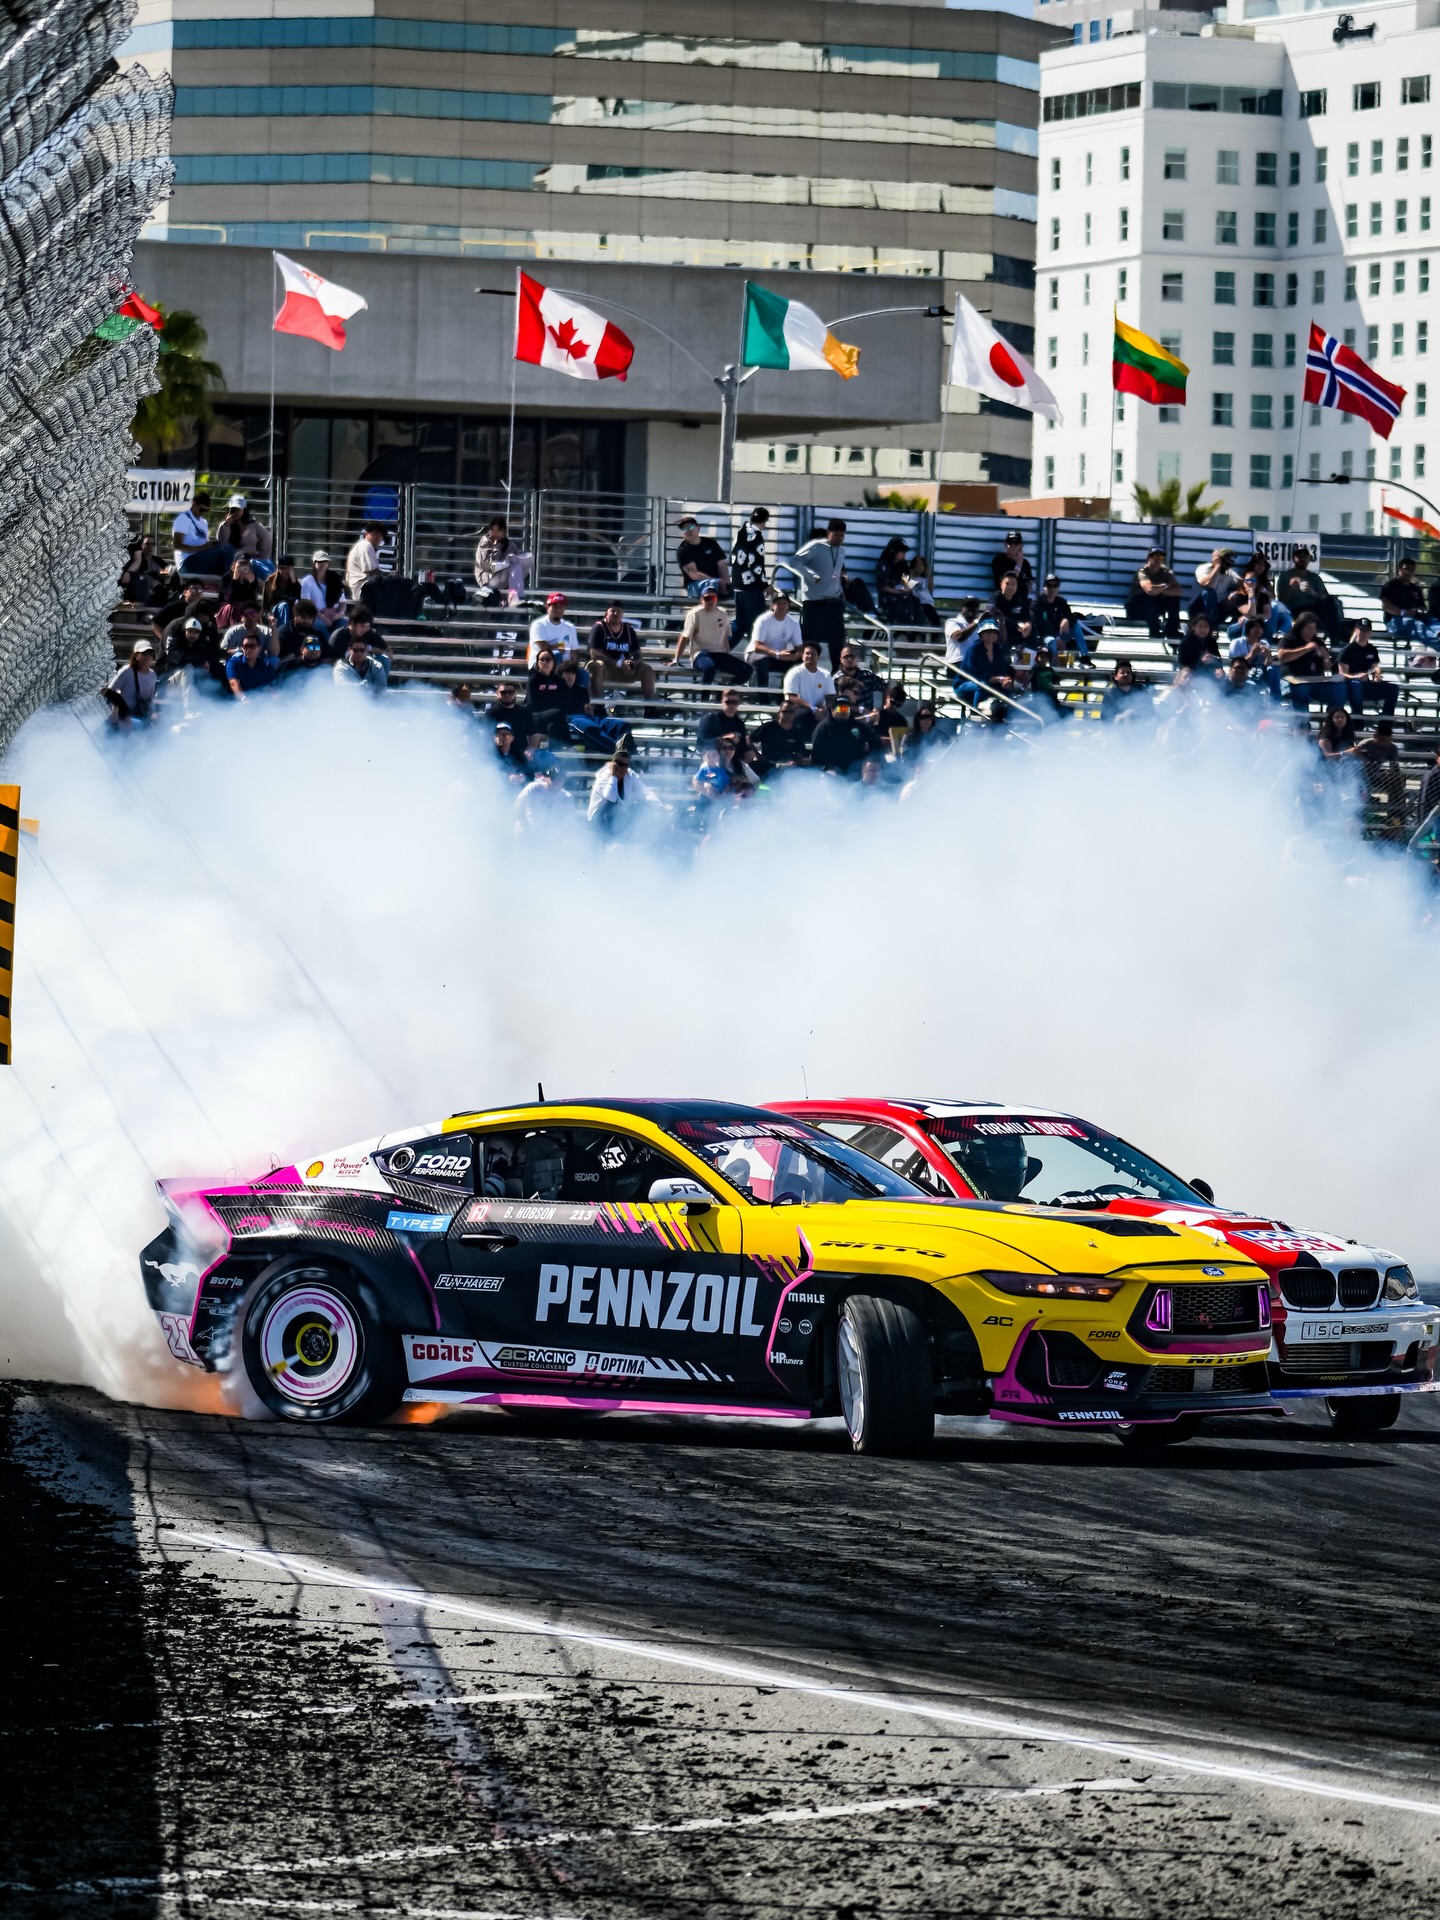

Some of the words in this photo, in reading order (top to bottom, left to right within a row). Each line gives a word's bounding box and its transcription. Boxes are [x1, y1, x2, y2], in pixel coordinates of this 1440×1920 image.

[130, 480, 180, 501] ECTION
[183, 482, 191, 502] 2
[1310, 544, 1318, 562] 3
[973, 1122, 1041, 1135] FORMULA
[1032, 1121, 1082, 1136] DRIFT
[415, 1155, 471, 1170] FORD
[411, 1166, 466, 1178] PERFORMANCE
[575, 1173, 600, 1182] RECARO
[504, 1207, 513, 1218] B.
[516, 1207, 556, 1219] HOBSON
[569, 1209, 594, 1220] 213
[820, 1240, 946, 1258] NITTO
[1258, 1240, 1340, 1250] MOLY
[438, 1277, 499, 1289] FUN-HAVER
[535, 1263, 765, 1337] PENNZOIL
[788, 1292, 825, 1304] MAHLE
[982, 1316, 1014, 1326] BC
[1307, 1325, 1340, 1336] ISC
[1344, 1324, 1389, 1334] SUSPENSION
[1187, 1355, 1248, 1364] NITTO
[530, 1362, 567, 1371] COILOVERS
[601, 1357, 645, 1375] OPTIMA
[1104, 1378, 1128, 1387] FORZA
[1058, 1411, 1124, 1420] PENNZOIL
